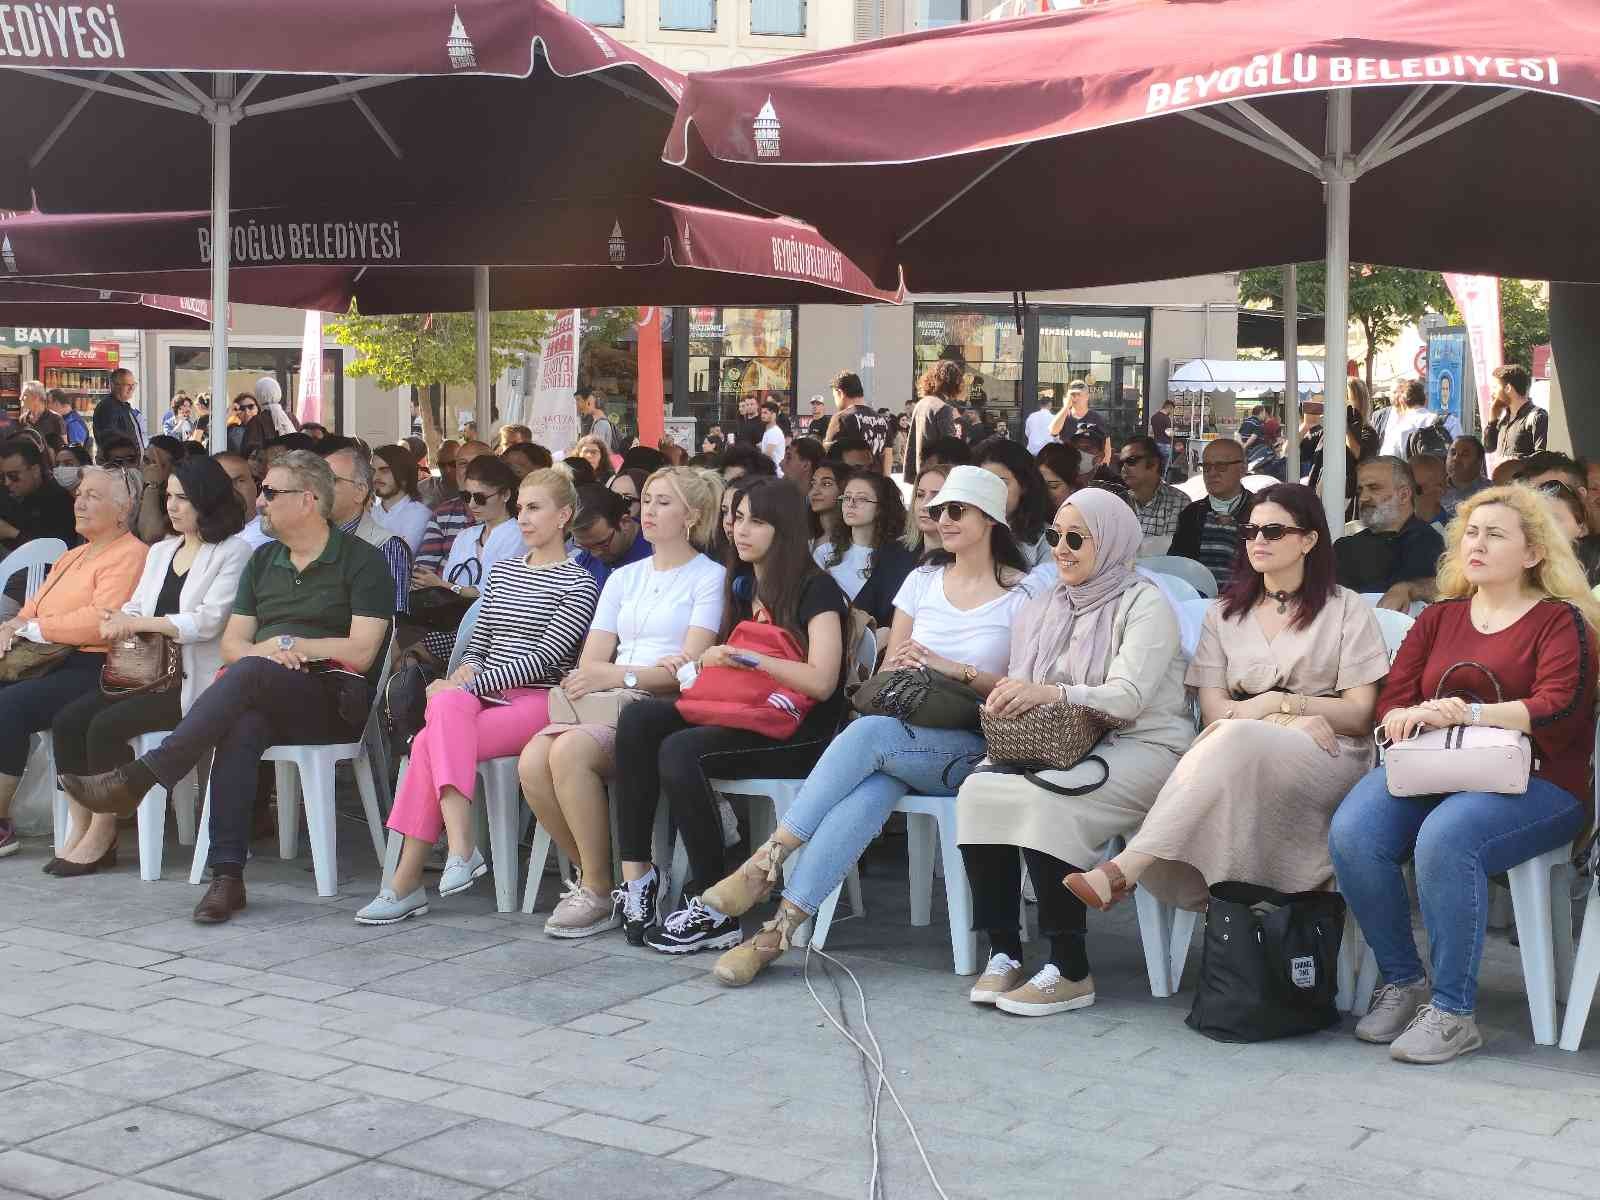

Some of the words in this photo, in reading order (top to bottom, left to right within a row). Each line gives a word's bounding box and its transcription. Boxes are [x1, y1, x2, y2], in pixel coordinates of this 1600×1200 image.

[0, 3, 125, 58] EDİYESİ
[1146, 51, 1317, 113] BEYOĞLU
[198, 219, 286, 262] BOĞLU
[288, 221, 401, 259] BELEDİYESİ
[772, 235, 805, 274] BEYOĞLU
